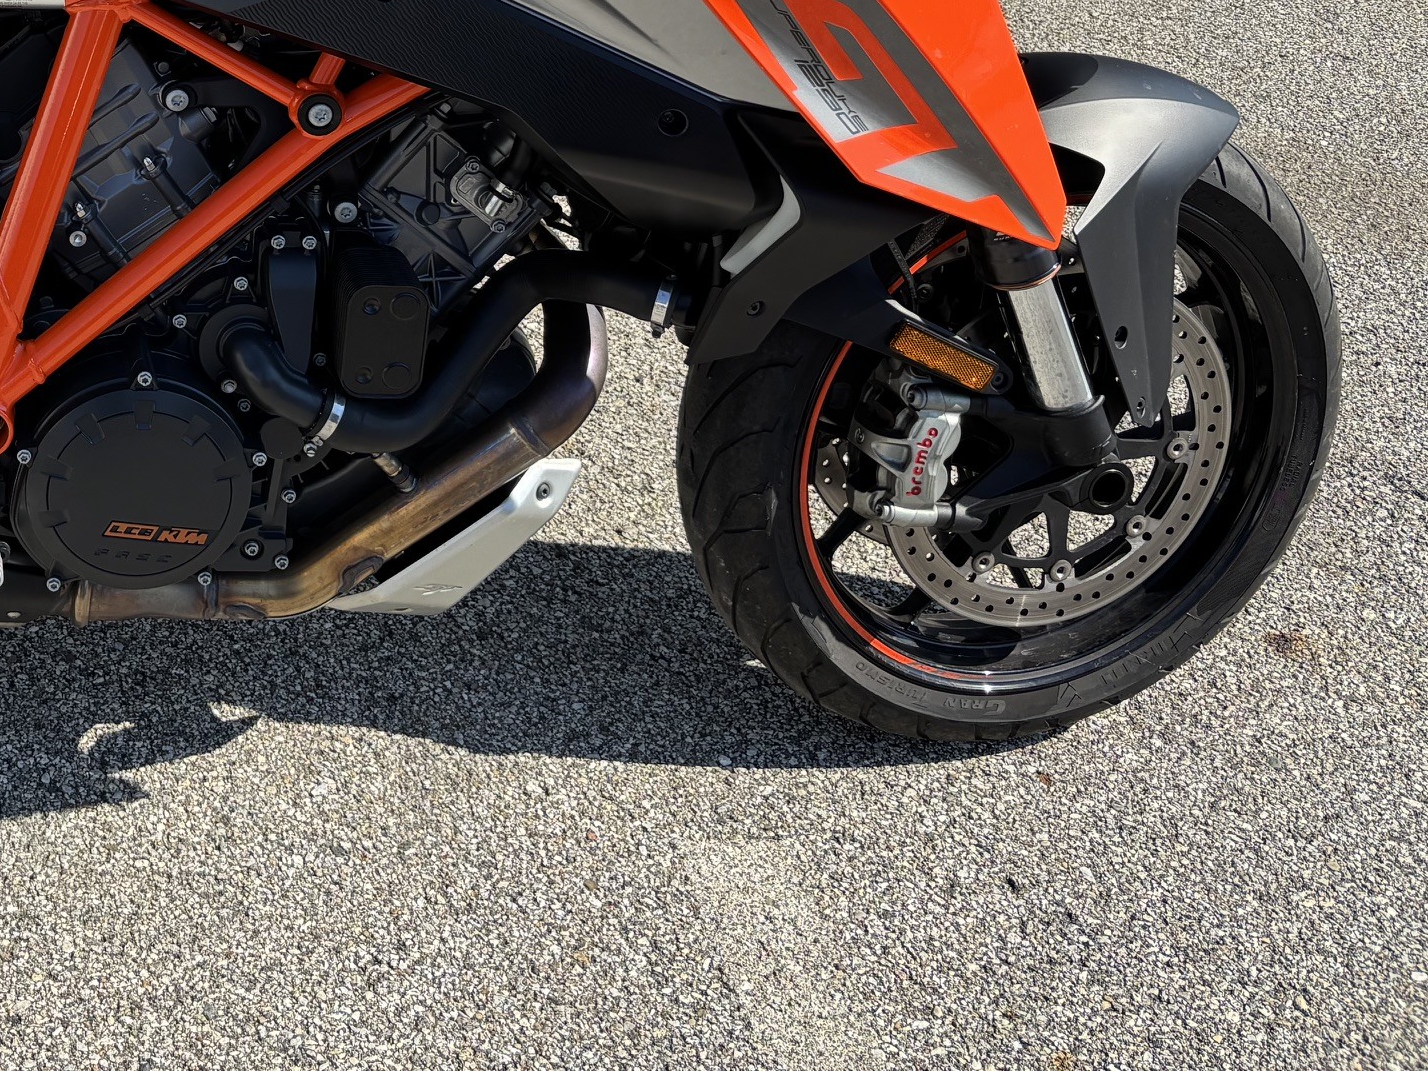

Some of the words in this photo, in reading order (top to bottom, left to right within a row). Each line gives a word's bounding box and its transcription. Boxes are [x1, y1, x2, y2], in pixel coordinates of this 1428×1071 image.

[794, 59, 862, 136] 1290
[905, 427, 939, 497] brembo
[157, 527, 208, 545] KTM
[854, 660, 928, 709] TURISMO
[943, 696, 1006, 716] GRAN
